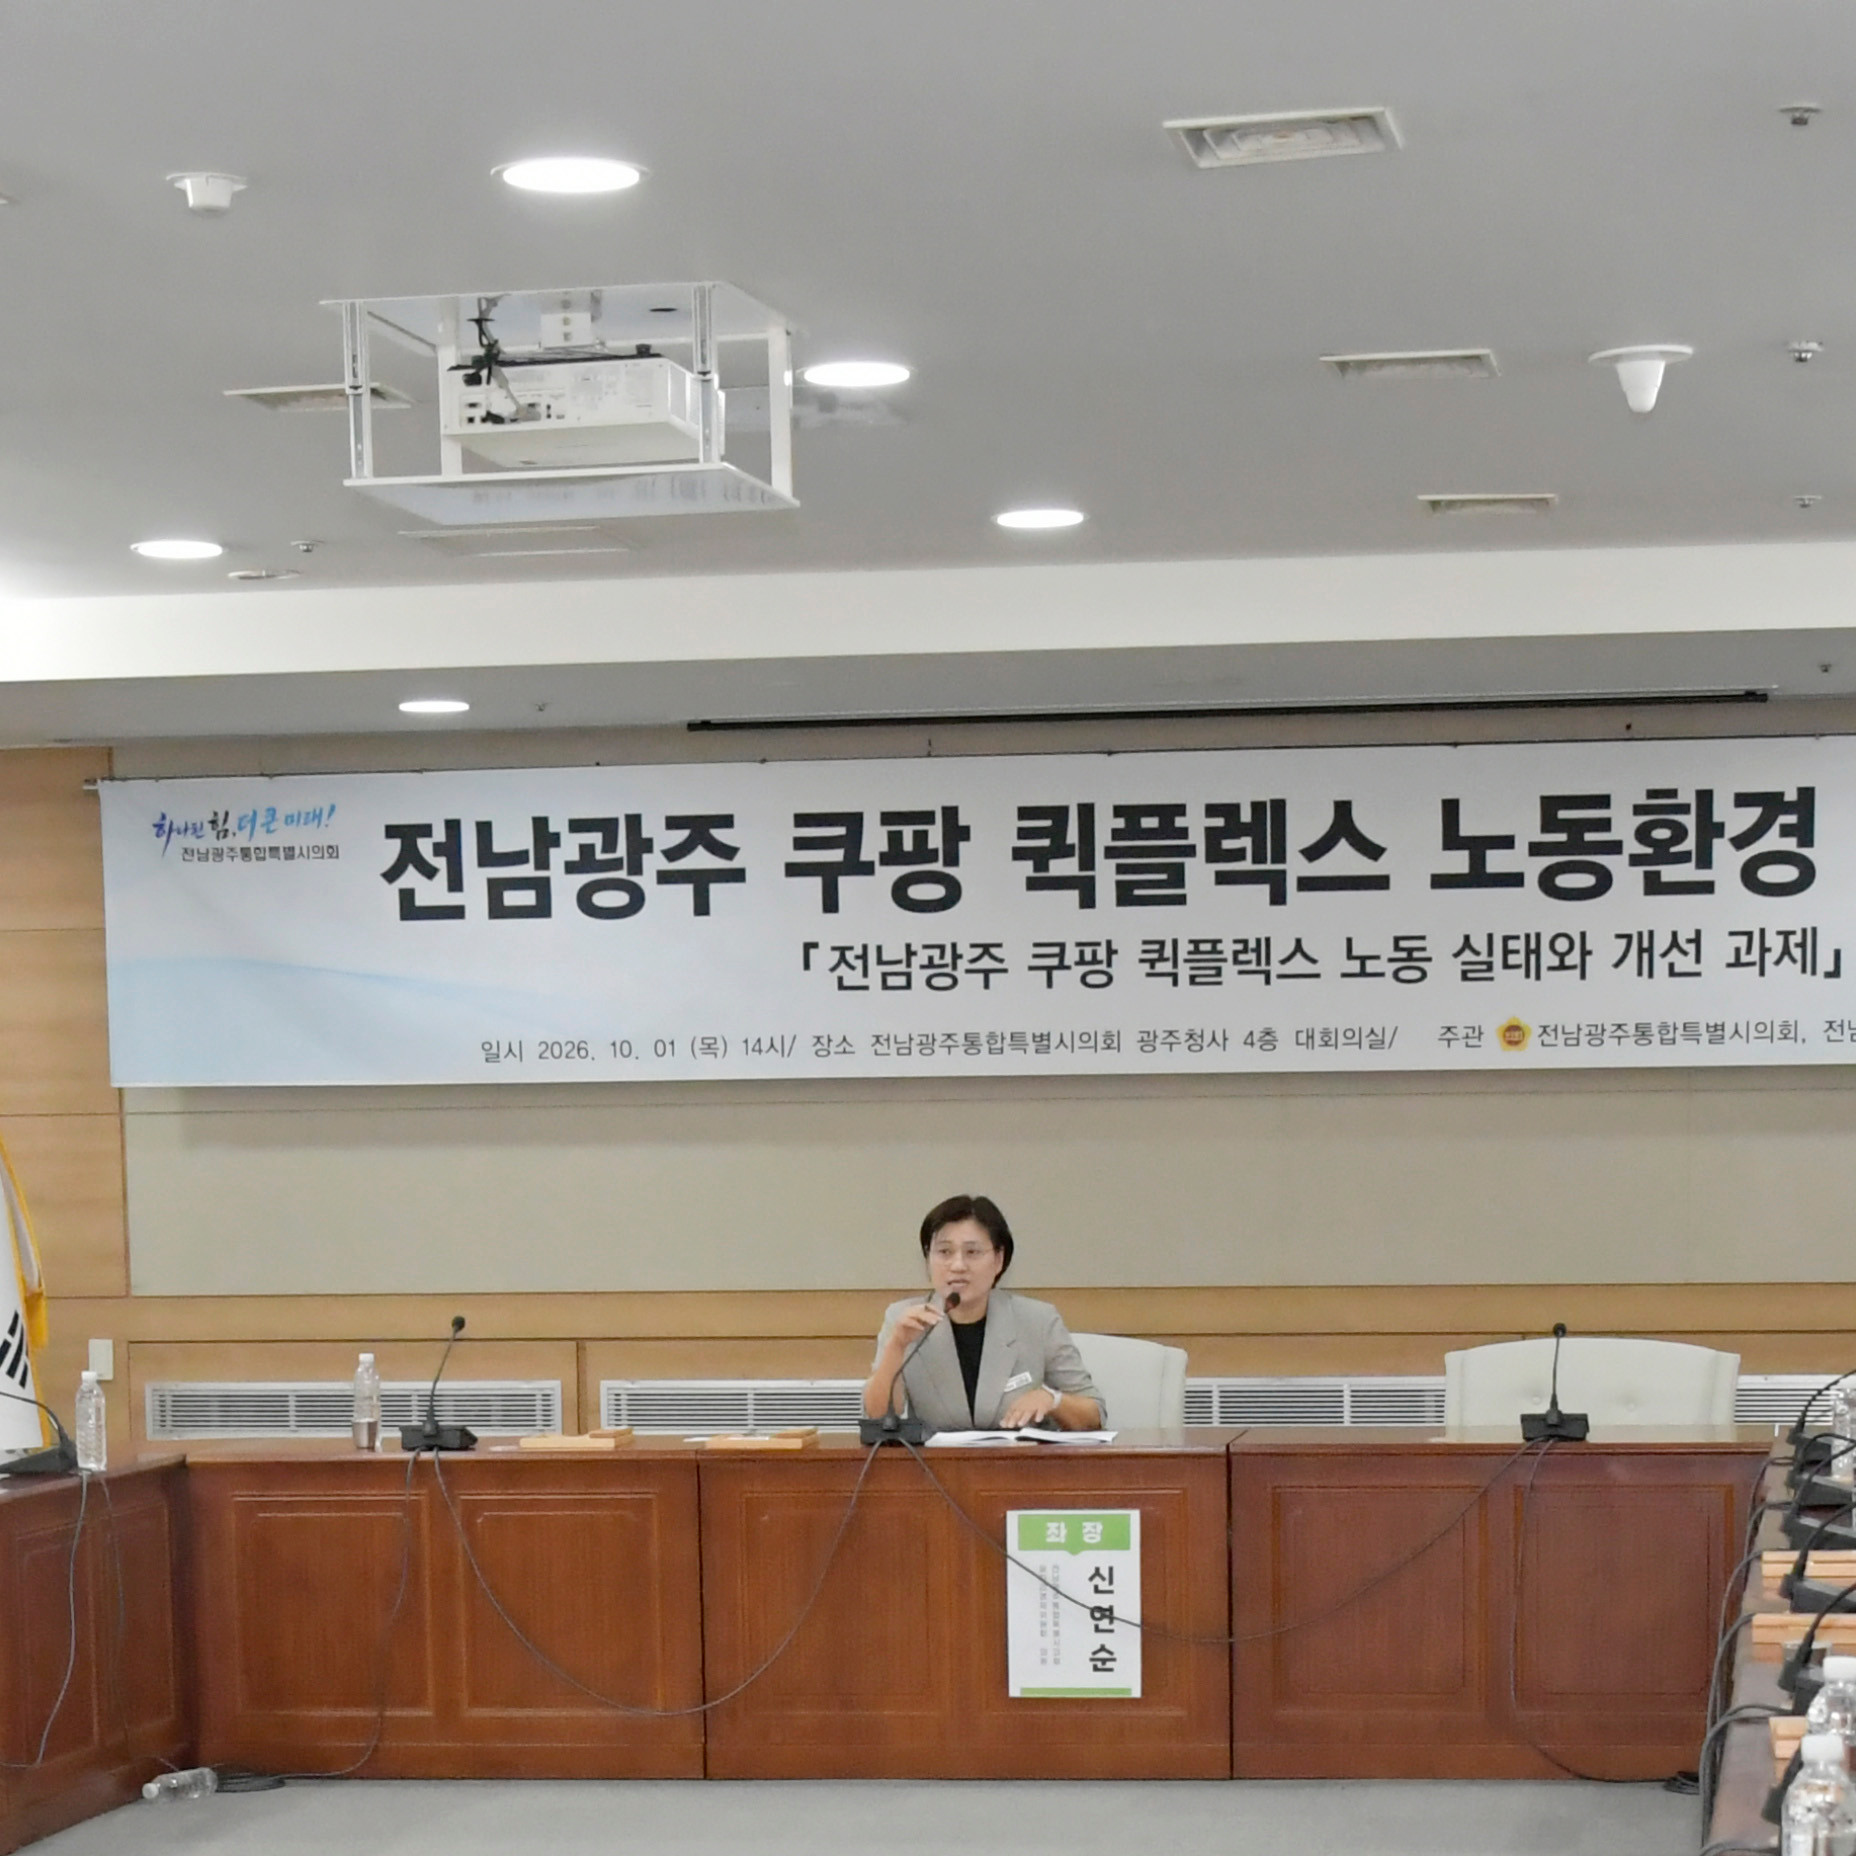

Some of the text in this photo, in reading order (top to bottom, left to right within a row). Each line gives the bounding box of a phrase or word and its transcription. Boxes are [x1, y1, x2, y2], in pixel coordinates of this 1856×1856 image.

[181, 844, 340, 863] 전남광주통합특별시의회
[379, 812, 747, 922] 전남광주
[784, 805, 972, 914] 쿠팡
[1011, 798, 1391, 910] 퀵플렉스
[1429, 786, 1817, 902] 노동환경
[1027, 938, 1119, 990] 쿠팡
[1137, 935, 1322, 988] 퀵플렉스
[1339, 934, 1433, 985] 노동
[1451, 930, 1594, 983] 실태와
[1611, 928, 1703, 980] 개선
[480, 1025, 1399, 1064] 일시 2026. 10. 01 (목) 14시/ 장소 전남광주통합특별시의회 광주청사 4층 대회의실/
[1437, 1024, 1485, 1049] 주관
[1537, 1019, 1807, 1048] 전남광주통합특별시의회,
